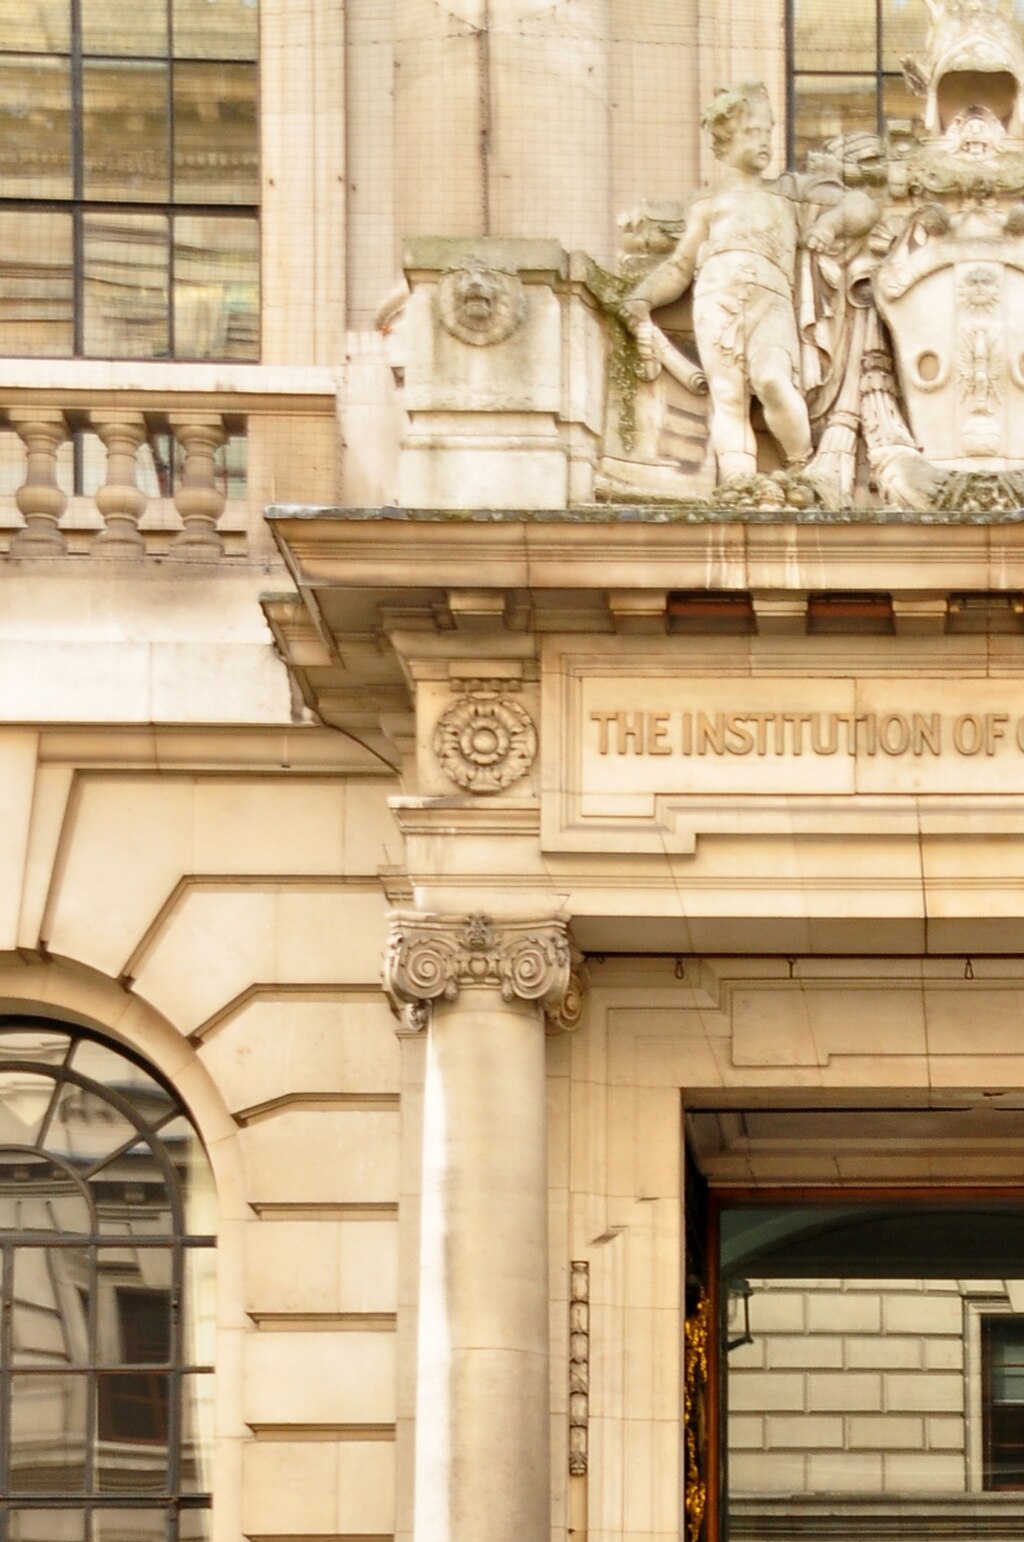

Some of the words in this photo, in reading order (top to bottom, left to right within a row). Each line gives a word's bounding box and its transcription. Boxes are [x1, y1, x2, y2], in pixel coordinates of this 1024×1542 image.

[590, 711, 673, 756] THE
[682, 711, 942, 757] INSTITUTION
[952, 712, 1010, 757] OF
